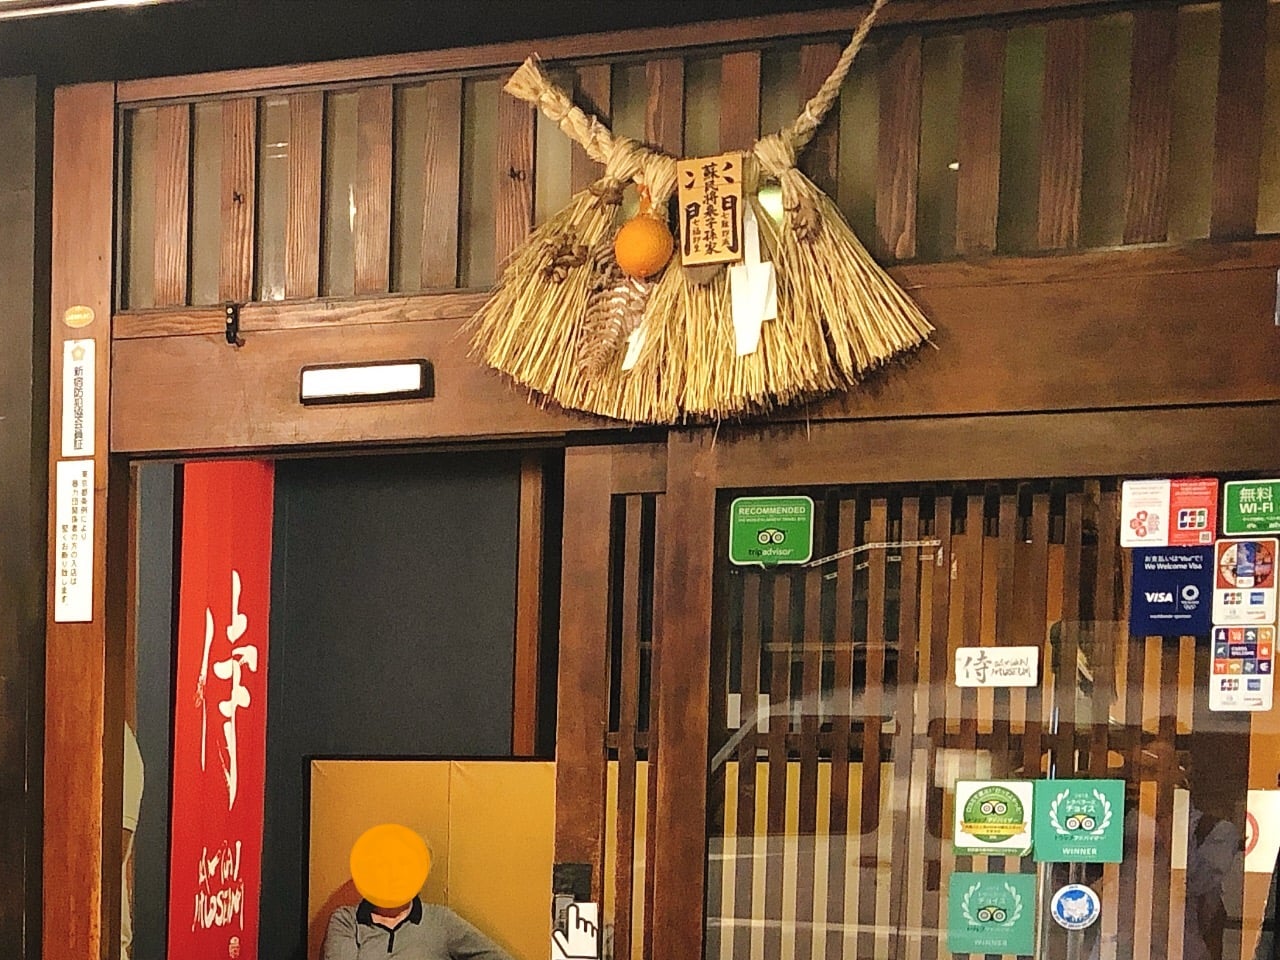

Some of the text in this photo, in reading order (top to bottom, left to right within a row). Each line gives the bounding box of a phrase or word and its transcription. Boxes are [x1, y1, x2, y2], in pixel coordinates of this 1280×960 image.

[1240, 487, 1273, 502] 無料
[738, 506, 806, 515] RECOMMENDED
[1157, 562, 1188, 570] Welcome
[1144, 592, 1173, 603] VISA
[964, 650, 992, 684] 侍
[1066, 805, 1096, 813] チョイス
[1062, 847, 1097, 855] WINNER
